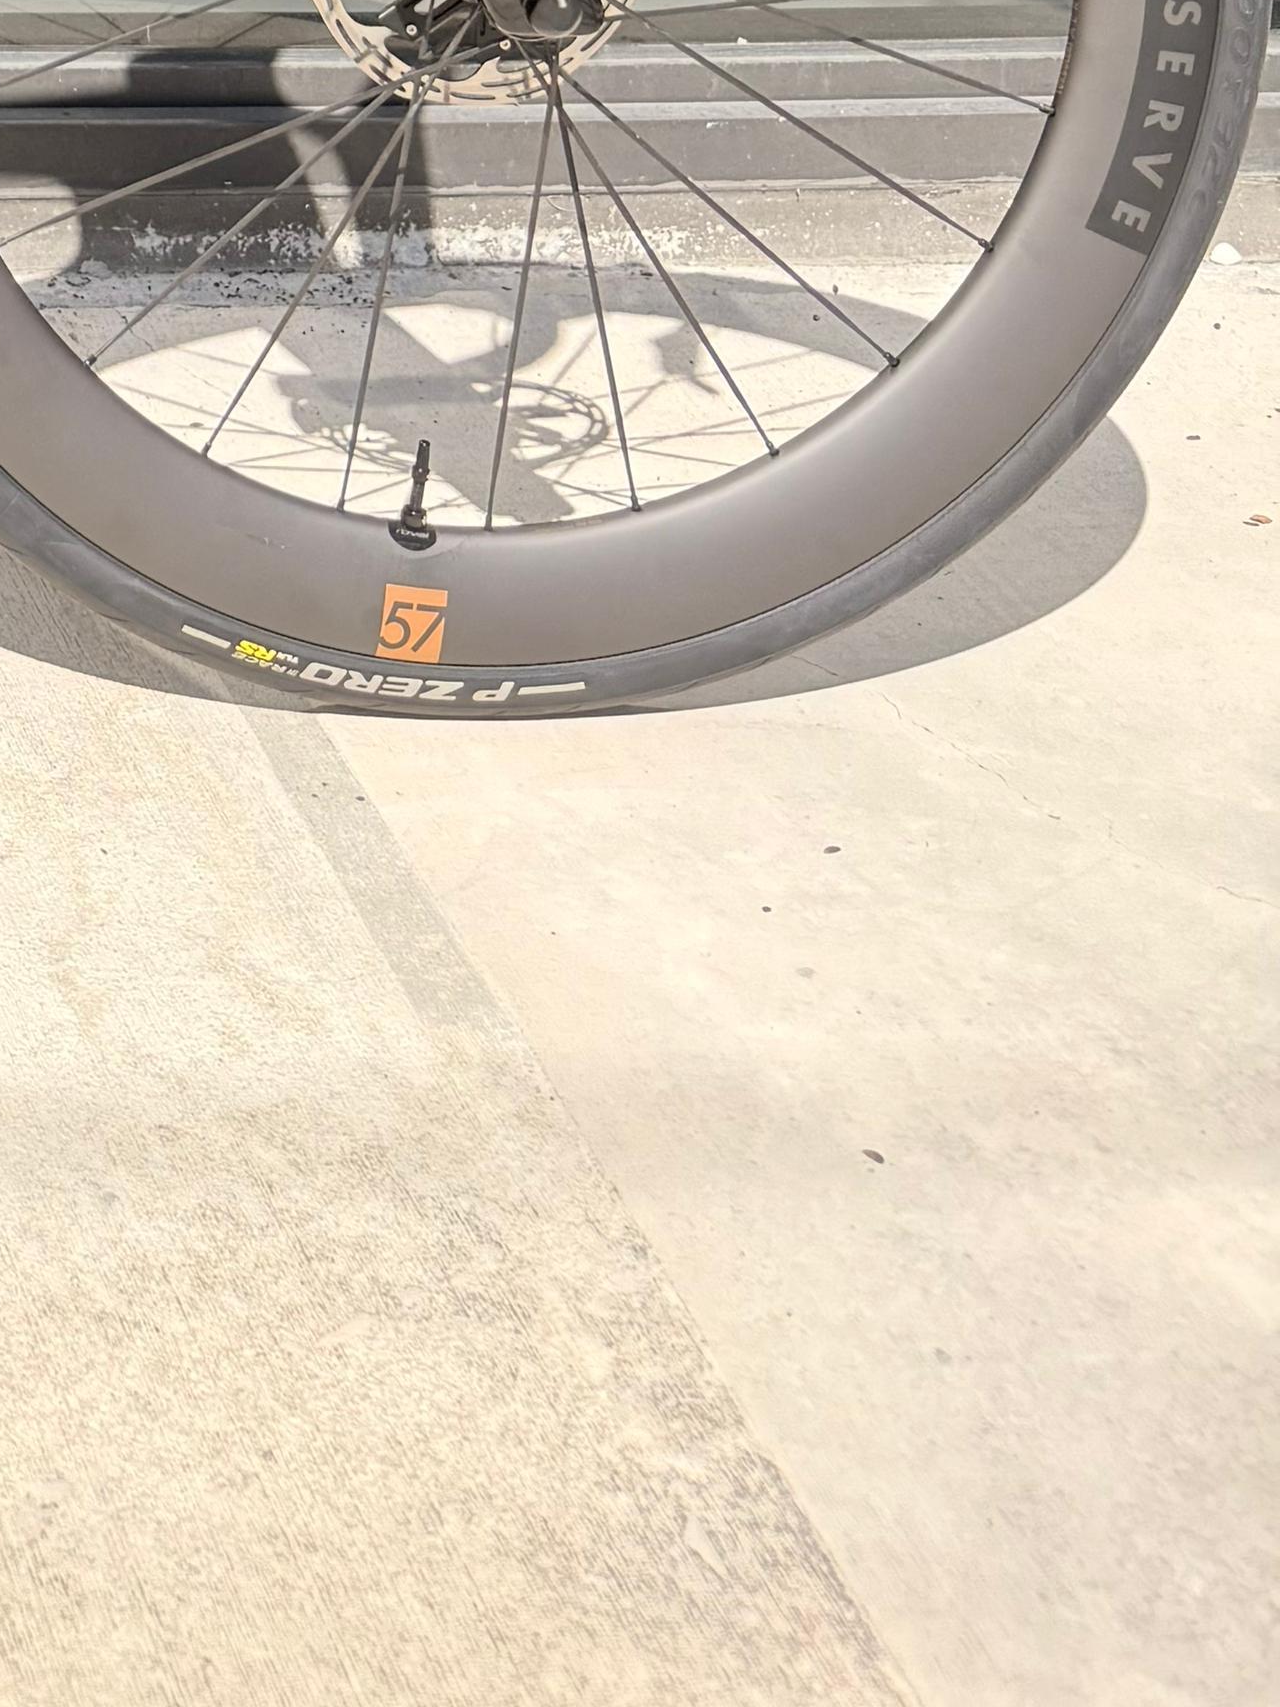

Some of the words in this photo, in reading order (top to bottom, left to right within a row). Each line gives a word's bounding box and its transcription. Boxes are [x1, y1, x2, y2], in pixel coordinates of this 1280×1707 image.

[379, 601, 445, 653] 57
[235, 639, 277, 661] RS
[299, 662, 465, 701] ZERO
[472, 681, 516, 702] P
